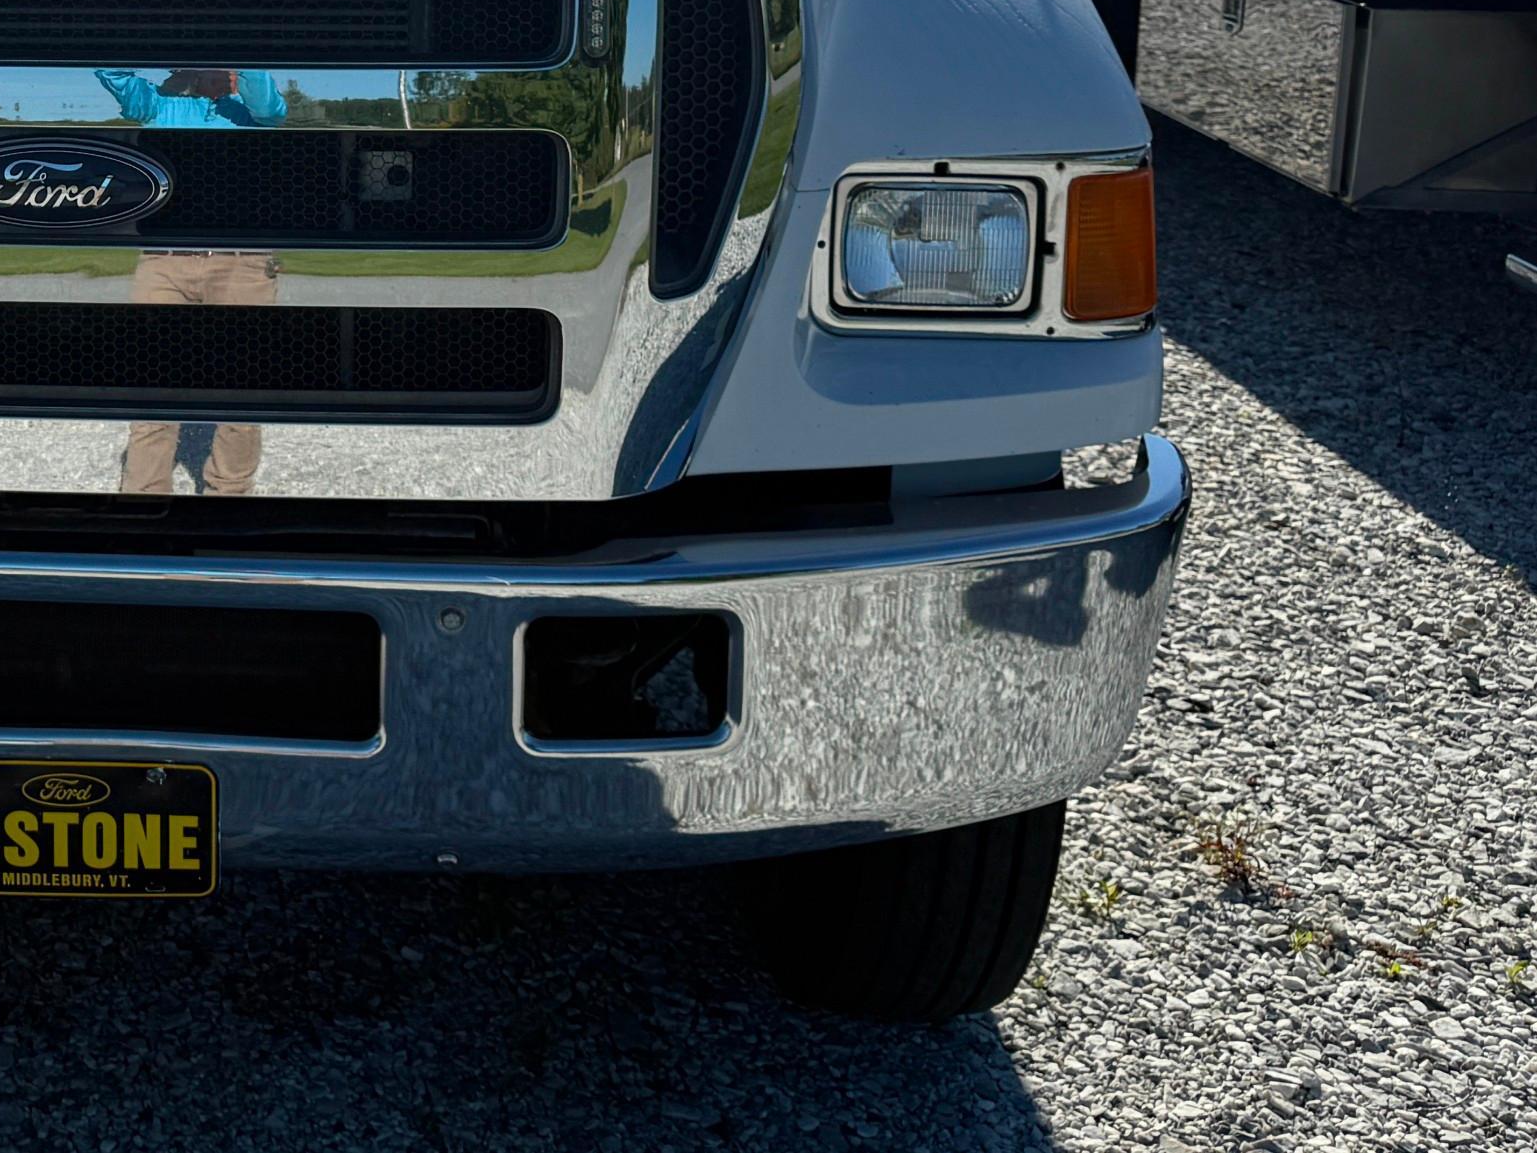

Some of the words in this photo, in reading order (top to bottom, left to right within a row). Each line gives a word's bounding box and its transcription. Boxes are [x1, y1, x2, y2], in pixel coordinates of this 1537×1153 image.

[40, 778, 92, 800] Ford
[4, 810, 200, 870] STONE
[2, 872, 105, 889] MIDDLEBURY,
[108, 874, 131, 889] VT.
